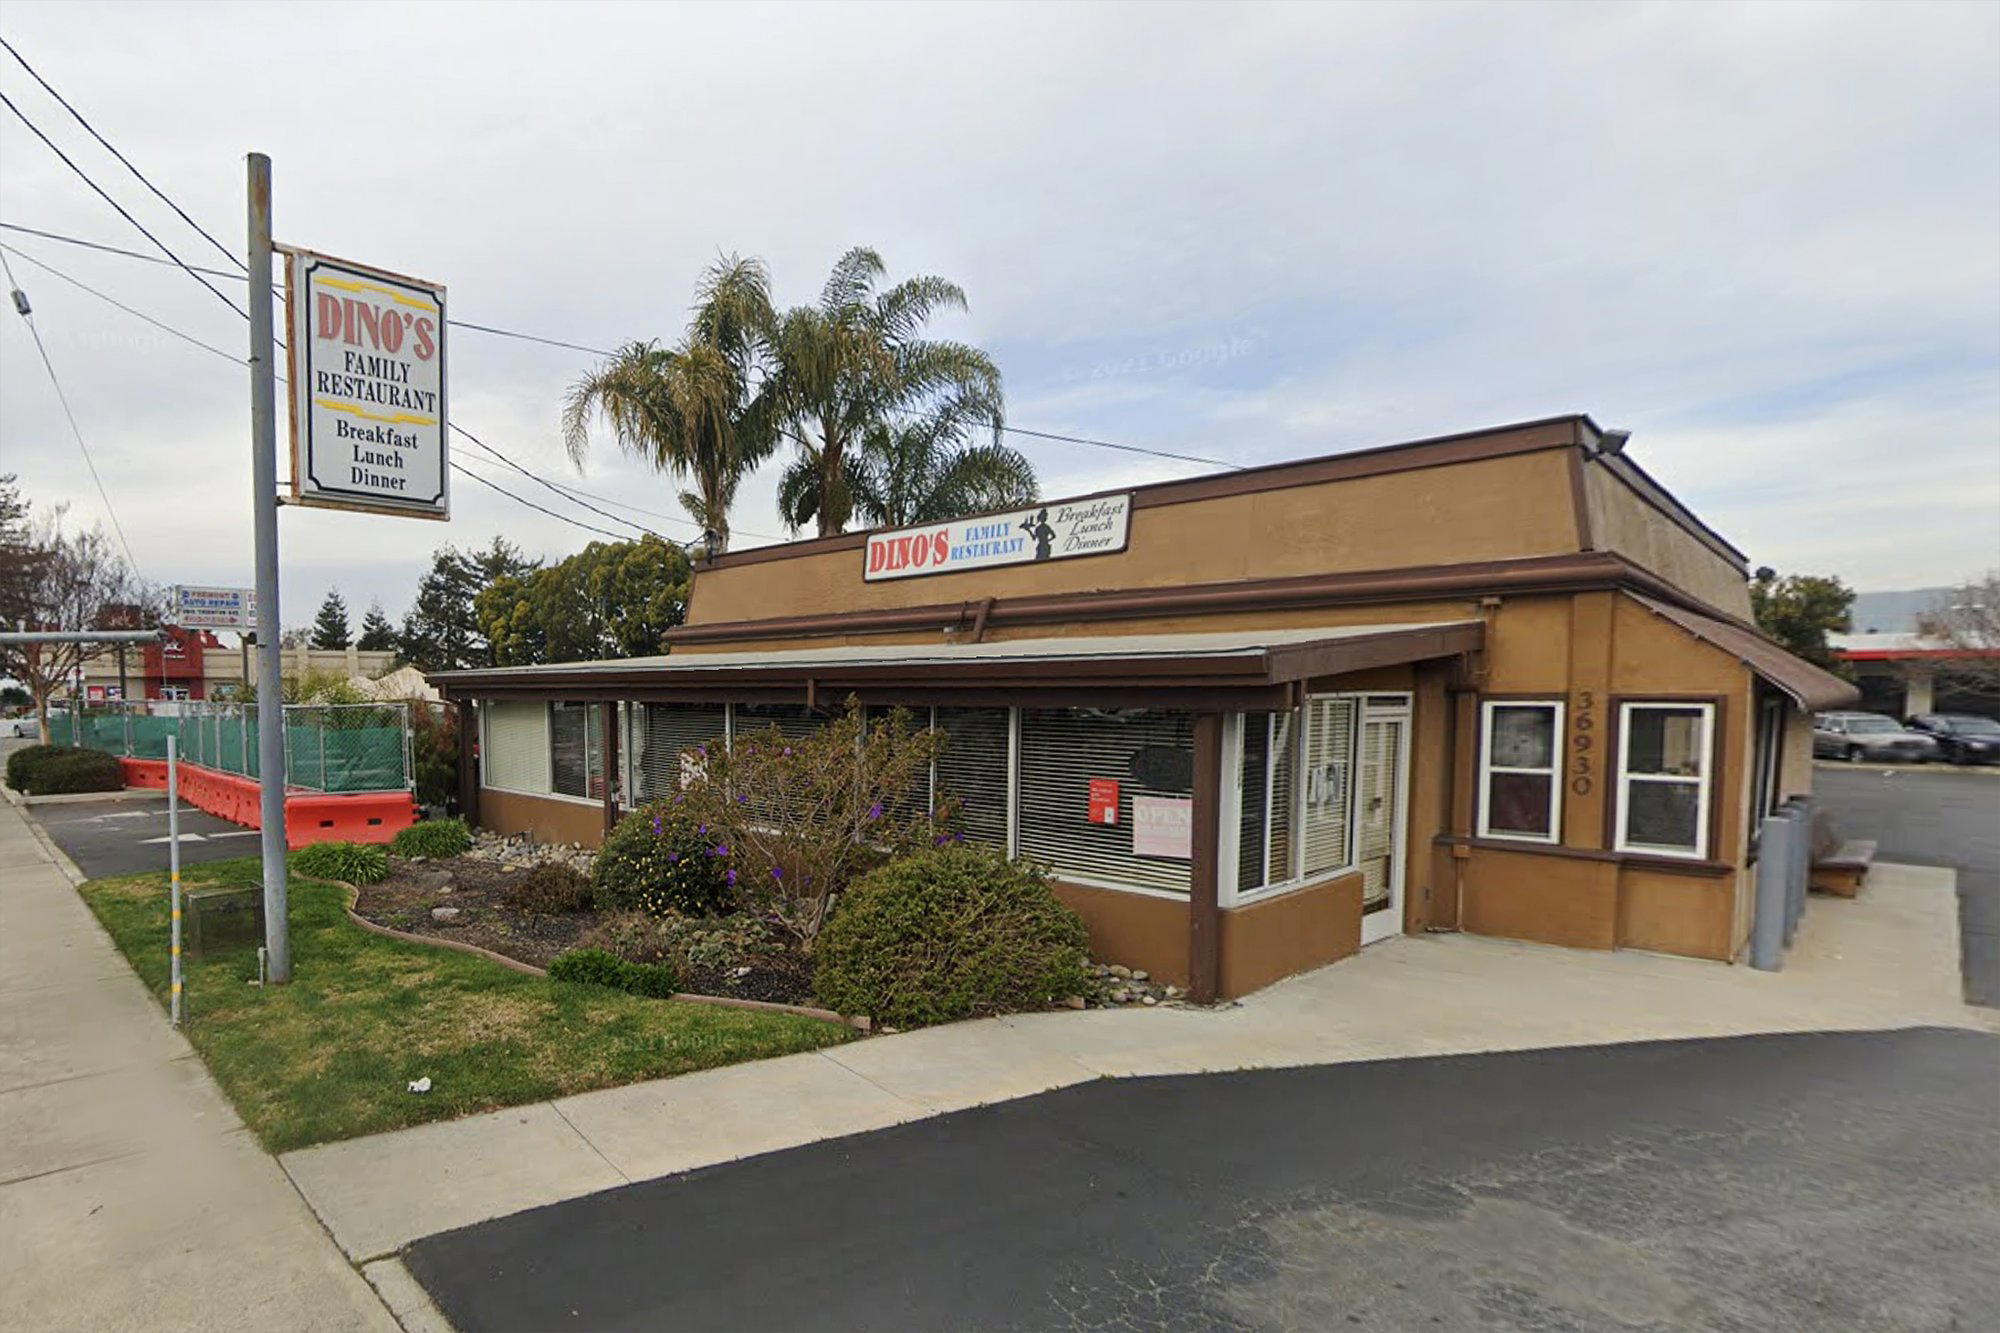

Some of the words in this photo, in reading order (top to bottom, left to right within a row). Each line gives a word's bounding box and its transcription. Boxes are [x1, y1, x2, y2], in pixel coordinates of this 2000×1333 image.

[317, 291, 435, 361] DINO'S
[344, 351, 411, 383] FAMILY
[317, 370, 436, 413] RESTAURANT
[337, 419, 419, 450] Breakfast
[353, 445, 404, 469] Lunch
[351, 466, 407, 491] Dinner
[1056, 501, 1125, 524] Breakfast
[965, 522, 1012, 542] FAMILY
[1070, 518, 1114, 537] Lunch
[869, 528, 949, 573] DINO'S
[951, 537, 1024, 561] RESTAURANT
[1063, 535, 1112, 552] Dinner
[1572, 691, 1594, 797] 36930
